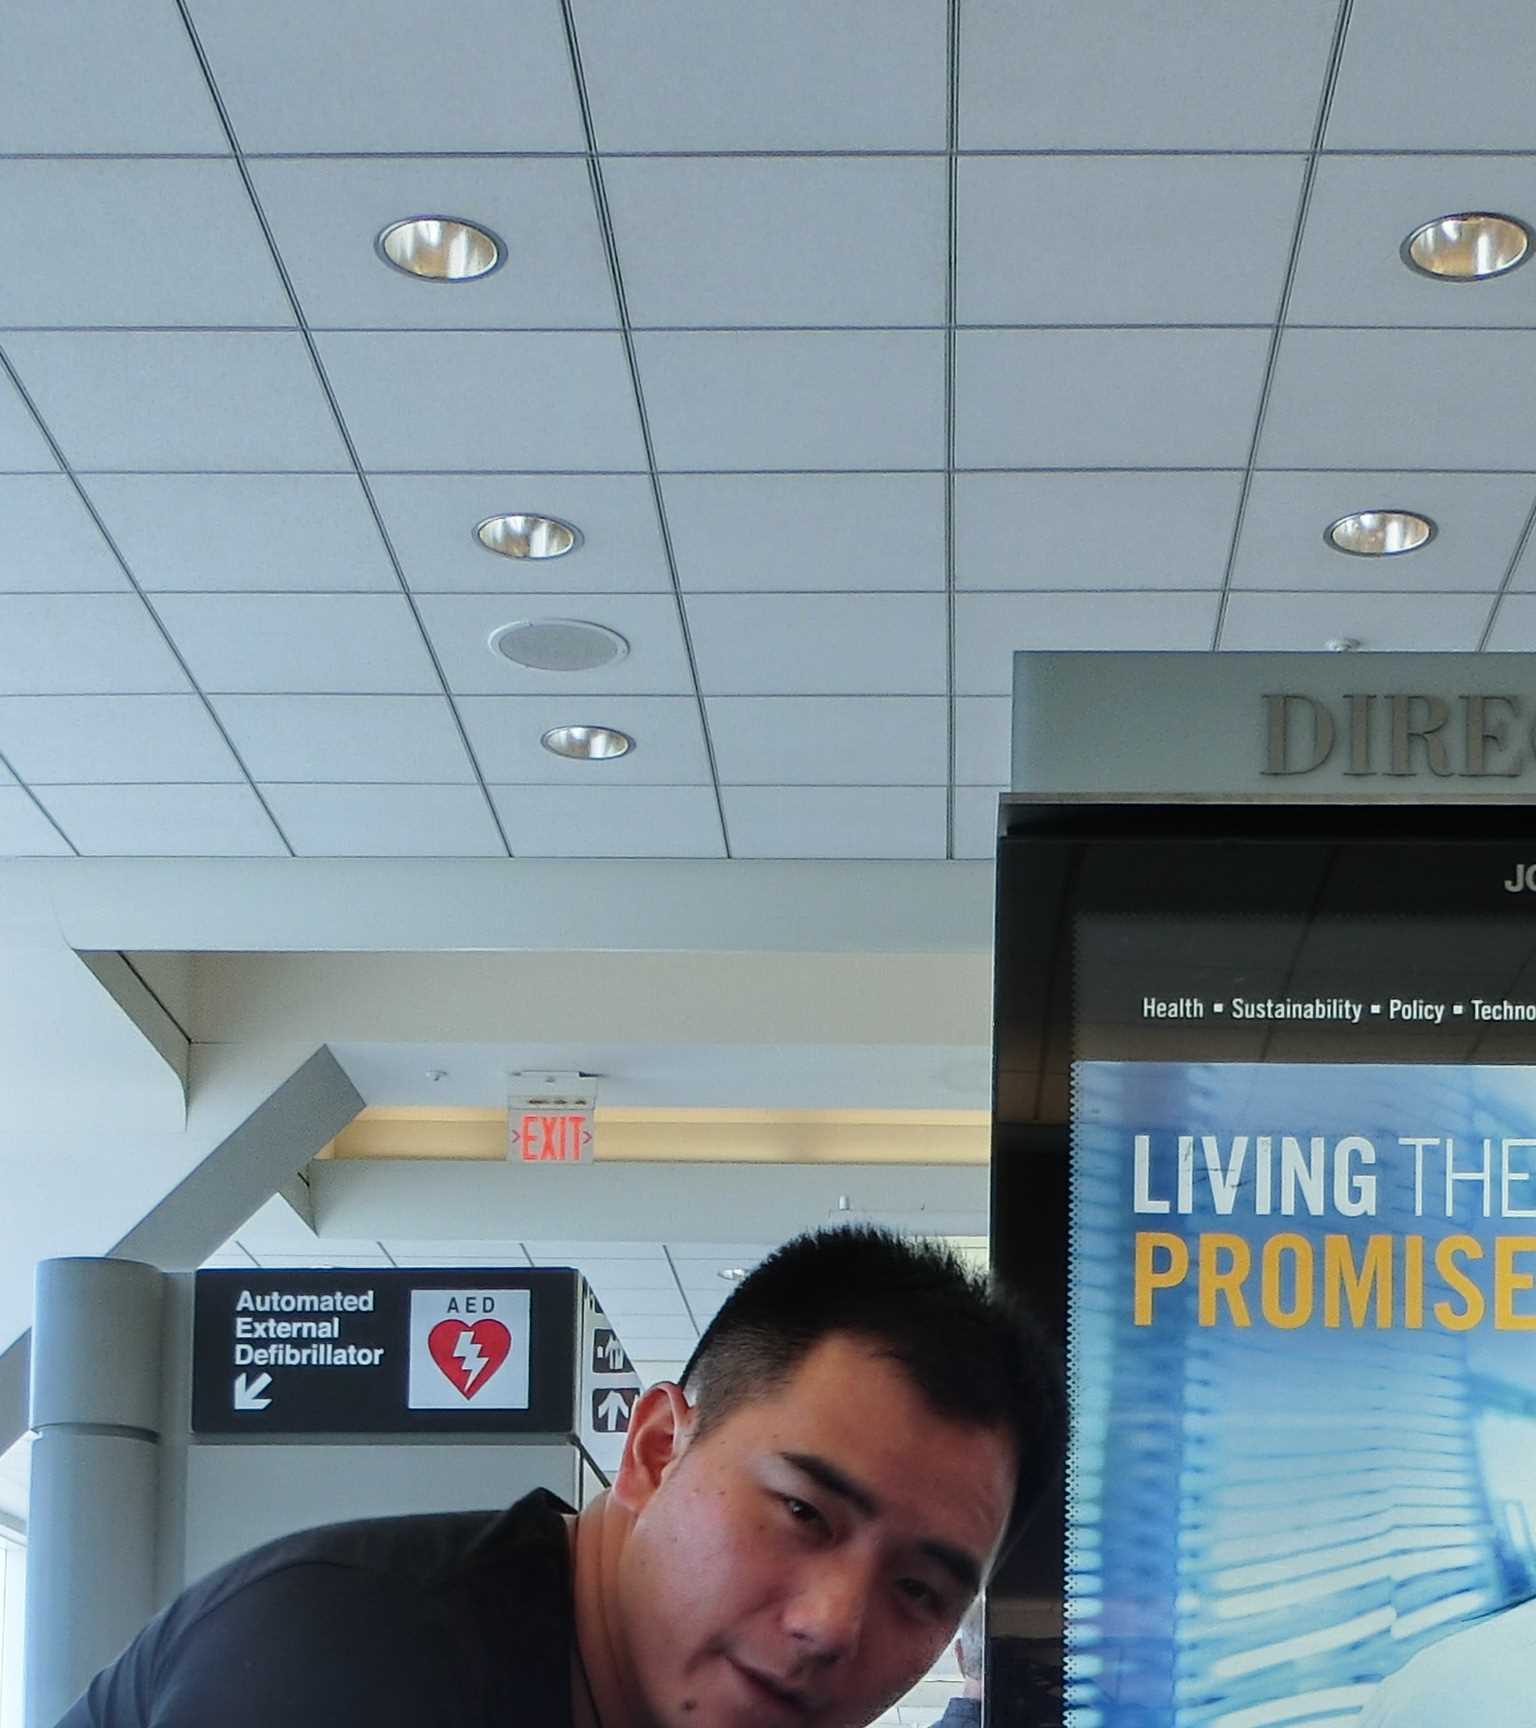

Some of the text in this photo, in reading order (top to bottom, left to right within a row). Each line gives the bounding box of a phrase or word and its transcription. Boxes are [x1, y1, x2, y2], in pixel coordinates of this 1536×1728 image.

[1143, 997, 1204, 1019] Health
[1231, 998, 1363, 1023] Sustainability
[1389, 1000, 1445, 1024] Policy
[521, 1114, 587, 1161] EXIT
[1133, 1134, 1377, 1217] LIVING
[235, 1290, 374, 1312] Automated
[446, 1296, 495, 1314] AED
[235, 1316, 340, 1339] External
[234, 1343, 385, 1366] Defibrillator
